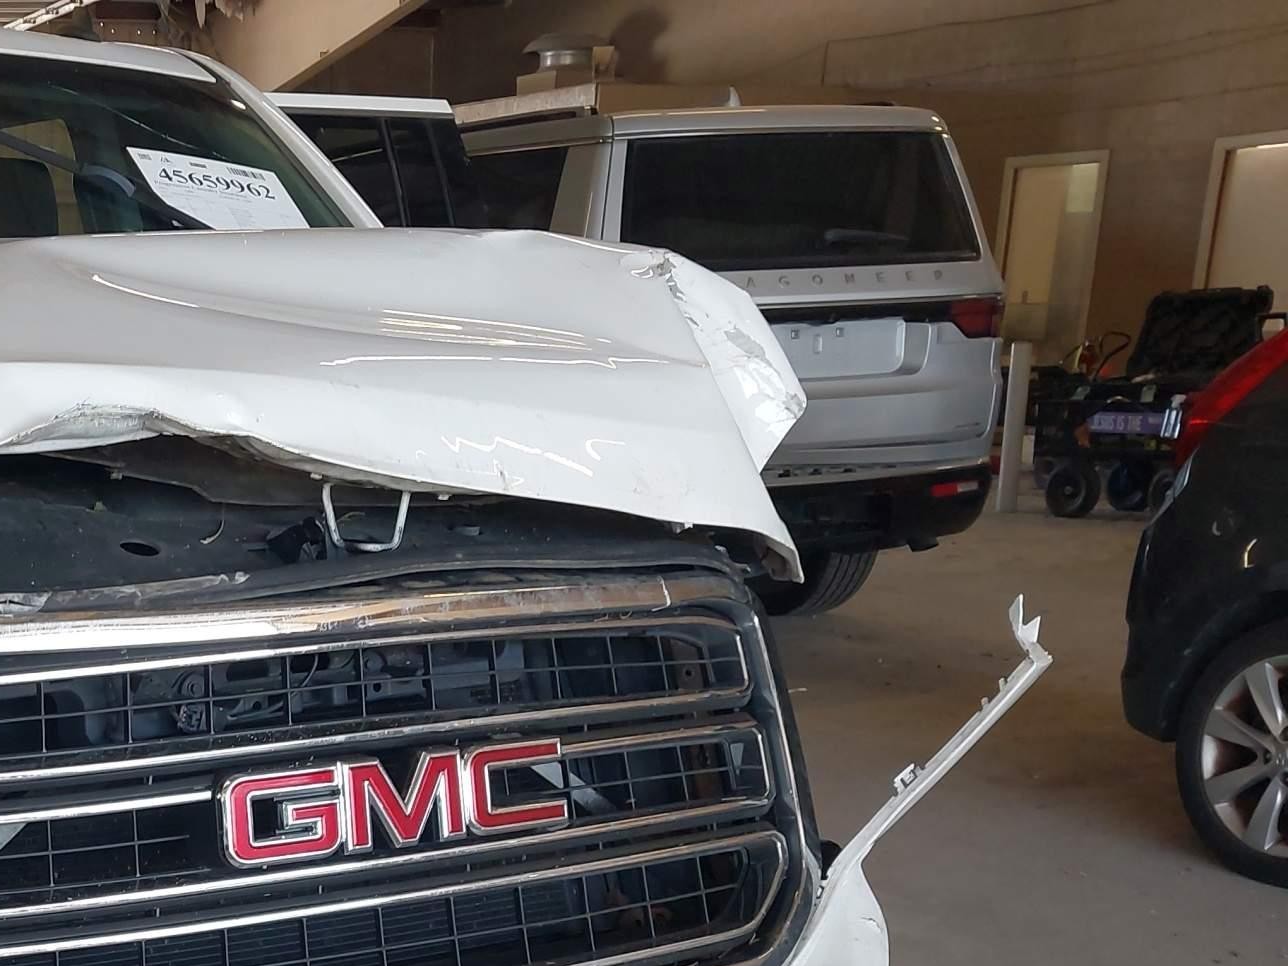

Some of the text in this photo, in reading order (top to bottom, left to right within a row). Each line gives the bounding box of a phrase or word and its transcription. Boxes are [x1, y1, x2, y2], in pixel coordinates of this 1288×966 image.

[158, 167, 276, 200] 45659962
[745, 269, 944, 288] AGONEER
[217, 738, 569, 869] GMC
